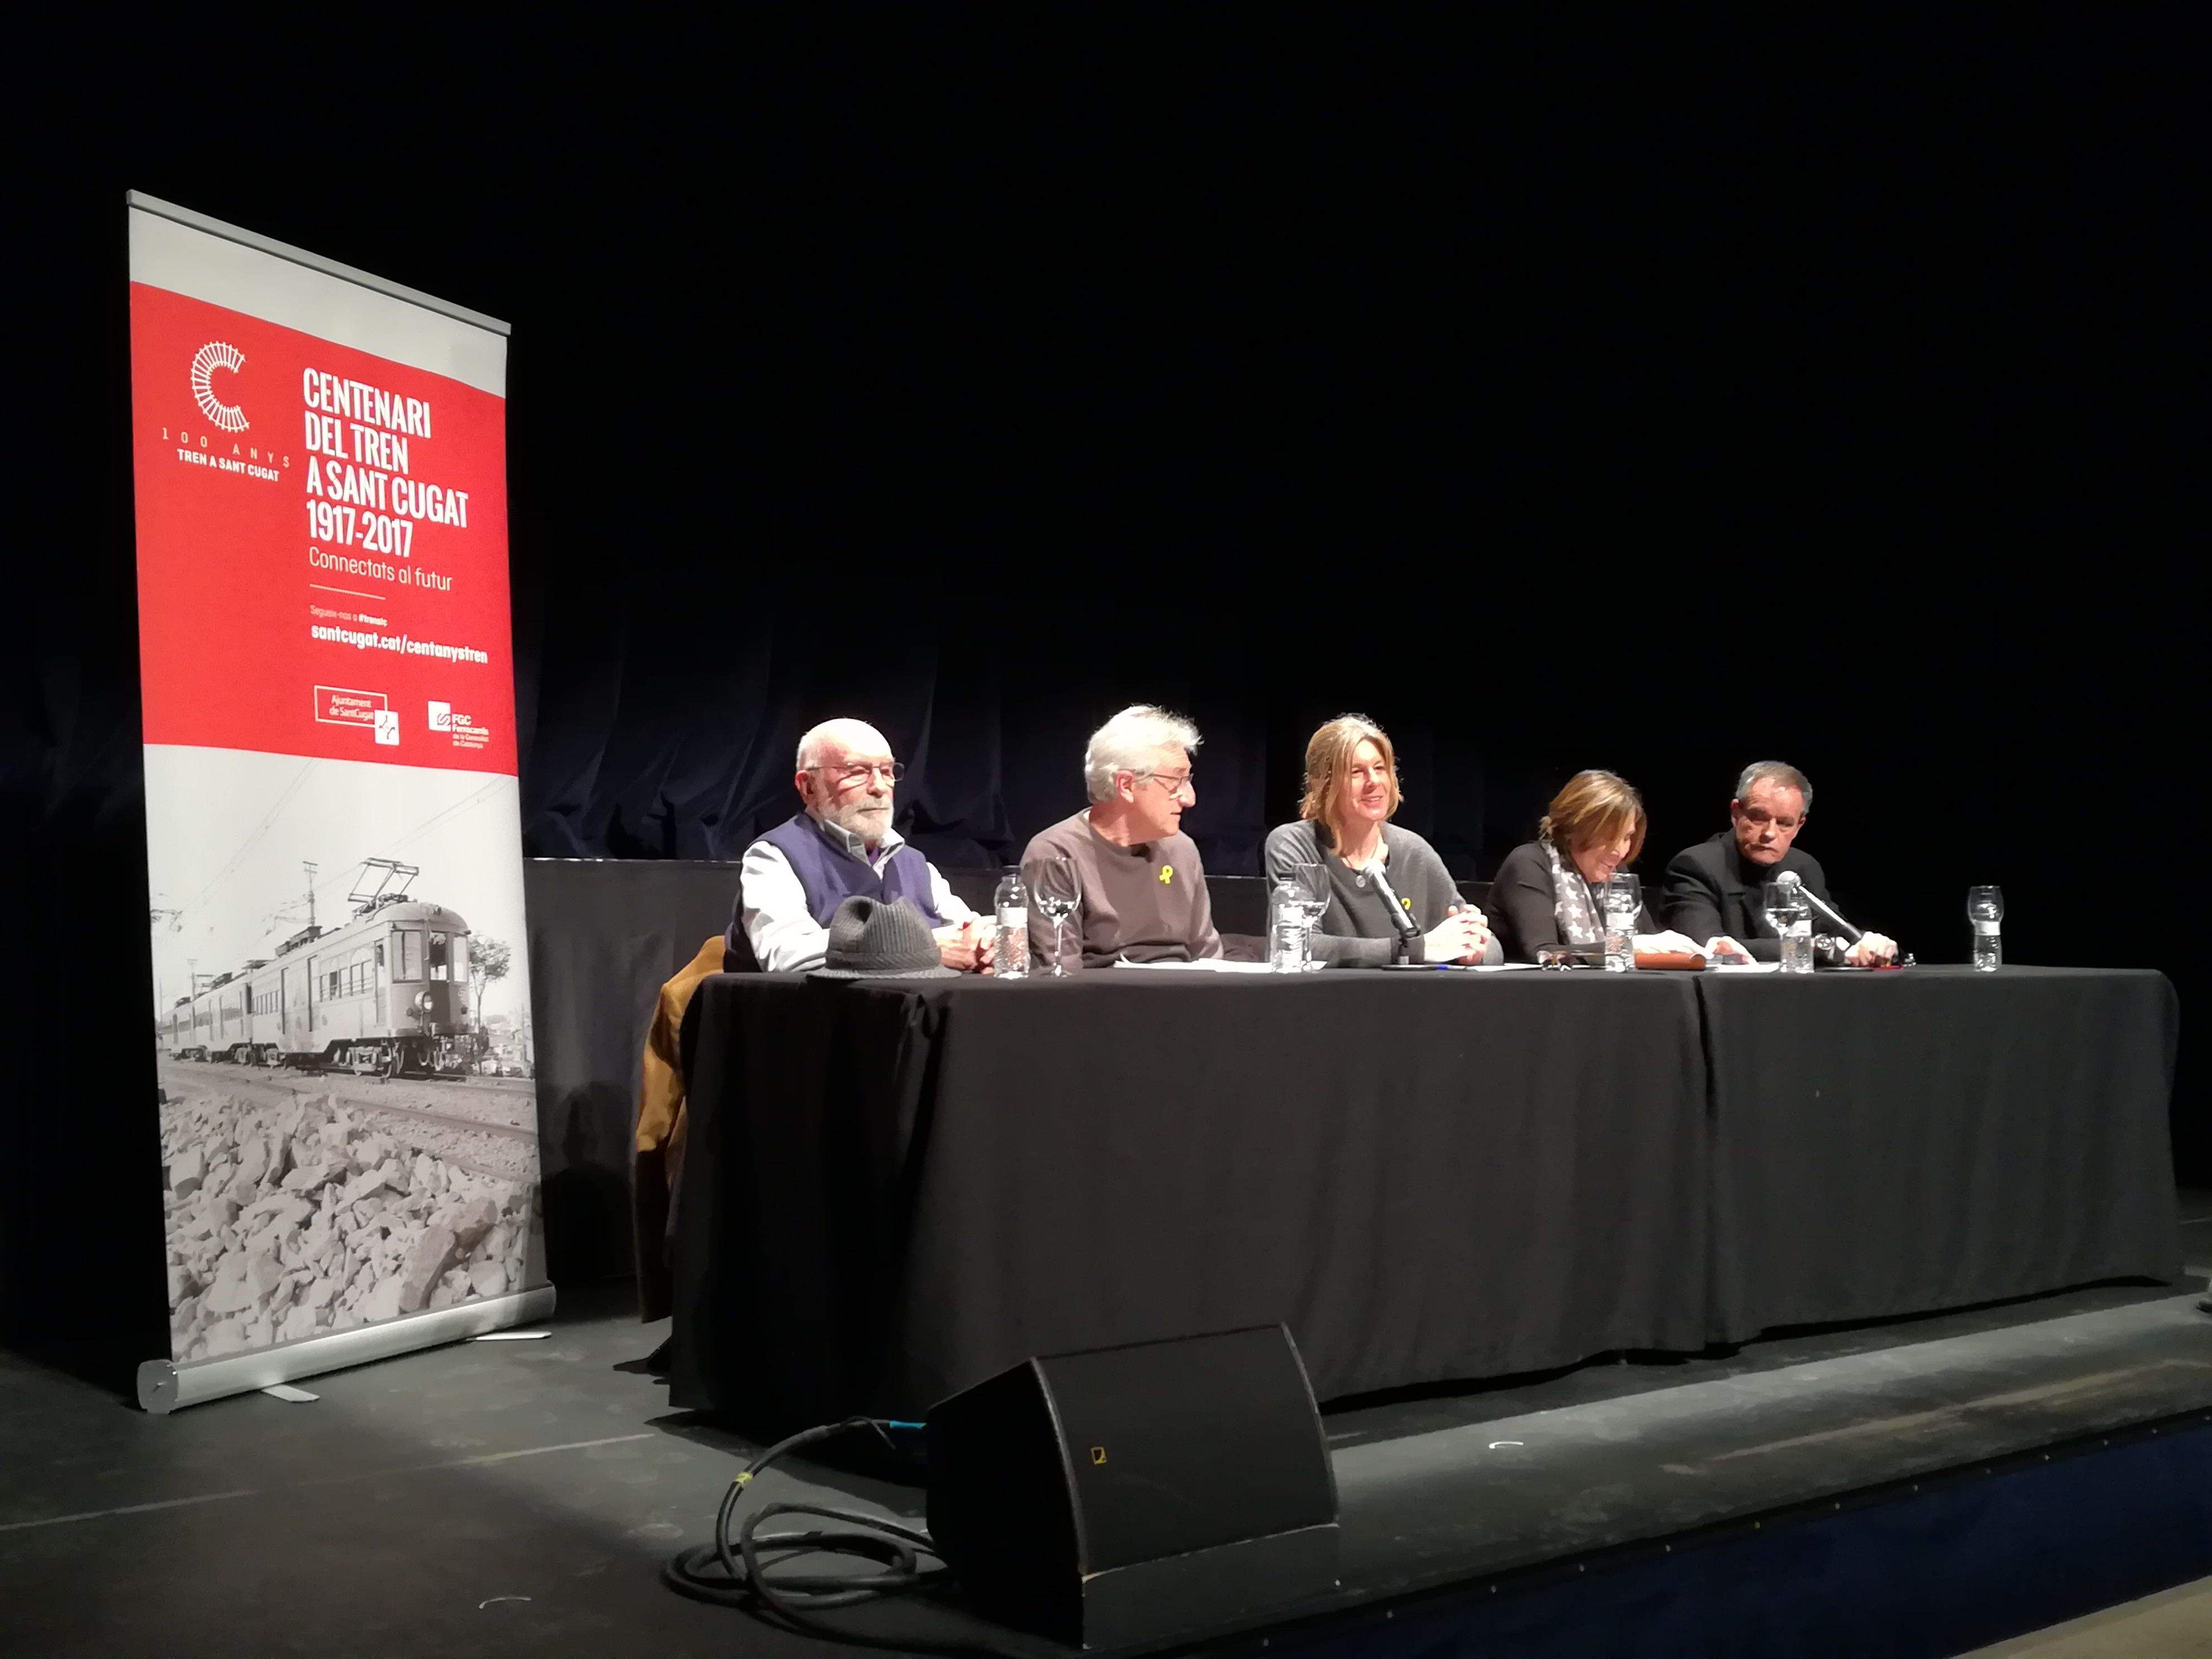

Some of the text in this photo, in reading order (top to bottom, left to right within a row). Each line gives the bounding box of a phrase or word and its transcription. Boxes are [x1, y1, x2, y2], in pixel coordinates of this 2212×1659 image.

[303, 367, 431, 438] CENTENARI
[162, 428, 289, 468] 100 ANYS
[305, 410, 409, 474] DEL TREN
[177, 448, 280, 482] TREN A SANT CUGAT
[307, 455, 468, 528] A SANT CUGAT
[307, 499, 413, 557] 1917-2017
[309, 546, 453, 591] Connectats al futur
[311, 625, 488, 664] santcugat.cat/centanystren
[452, 714, 472, 726] FGC
